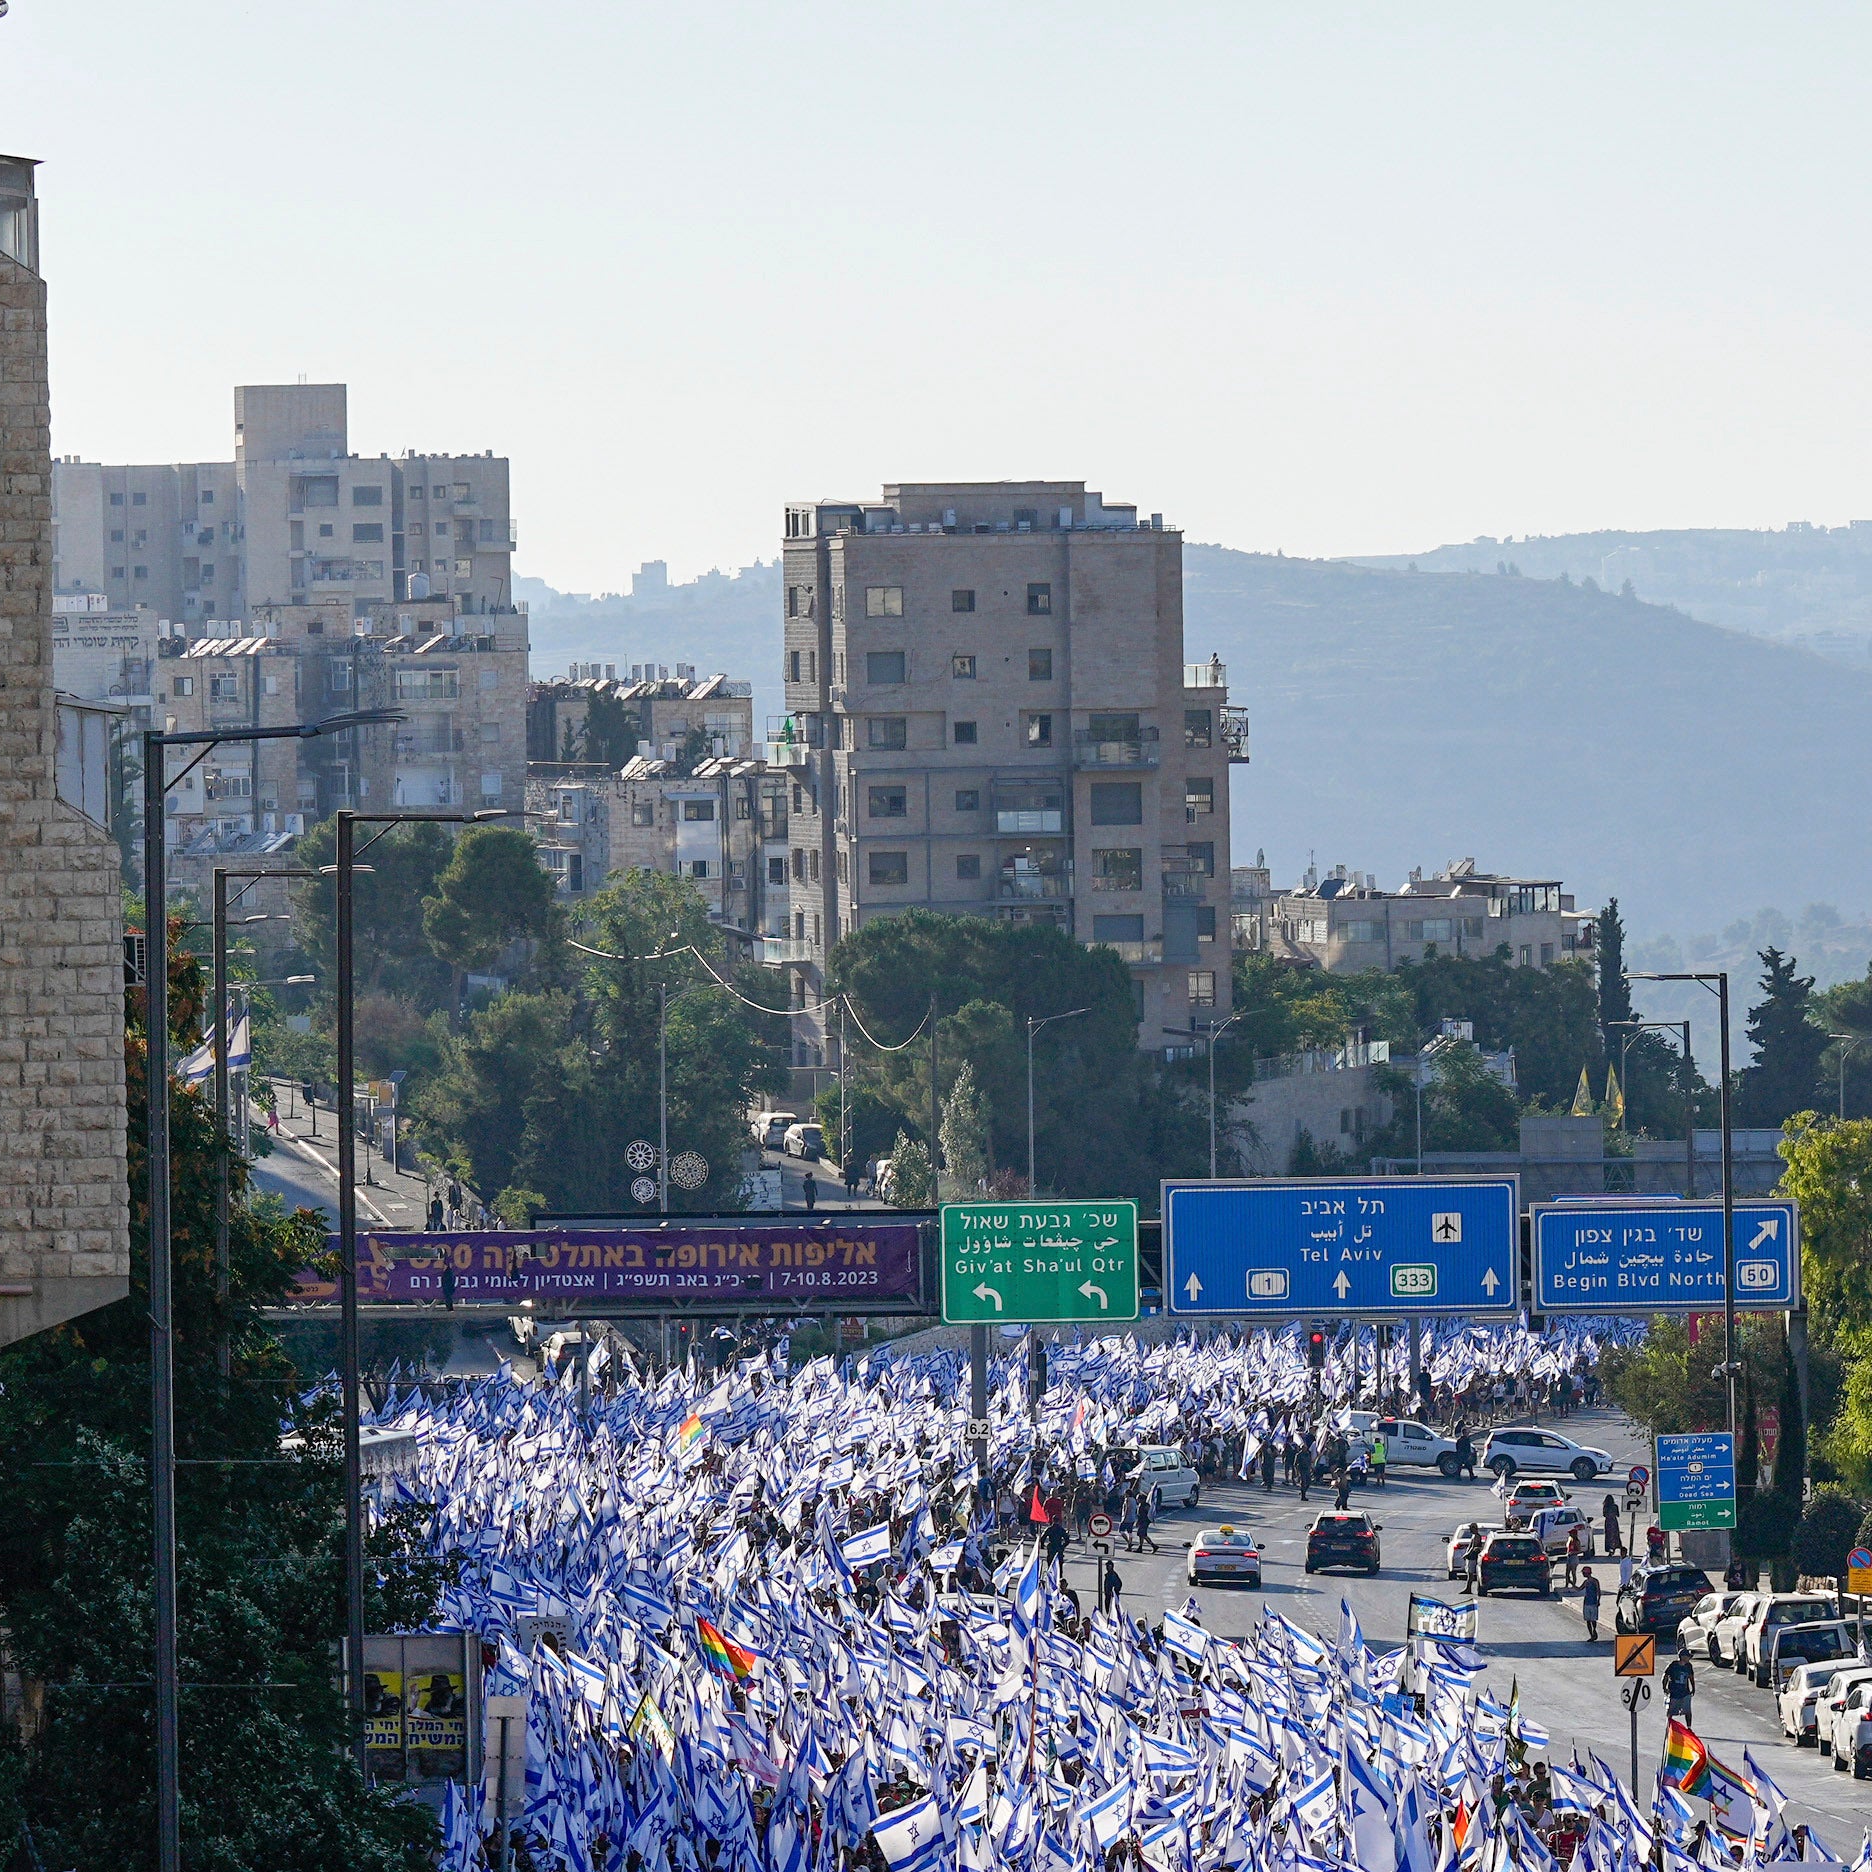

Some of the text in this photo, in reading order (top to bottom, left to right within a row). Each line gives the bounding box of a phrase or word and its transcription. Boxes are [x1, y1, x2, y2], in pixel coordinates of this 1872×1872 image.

[1301, 1196, 1385, 1215] תל אביב
[960, 1212, 1009, 1230] שאול
[1020, 1214, 1071, 1230] גבעת
[1575, 1228, 1613, 1247] צפון
[1623, 1227, 1656, 1246] בגין
[655, 1244, 761, 1269] אירופה
[769, 1237, 877, 1268] אליפות
[1300, 1247, 1383, 1262] Tel Aviv
[955, 1257, 1124, 1274] Giv'at Sha'ul Qtr
[534, 1273, 595, 1289] אצטדיון
[676, 1273, 709, 1288] באב
[781, 1270, 879, 1287] 7-10.8.2023
[1398, 1273, 1429, 1287] 333
[1554, 1271, 1725, 1292] Begin Blvd North
[1747, 1268, 1769, 1281] 50
[1264, 1277, 1271, 1290] 1
[970, 1422, 989, 1436] 6.2
